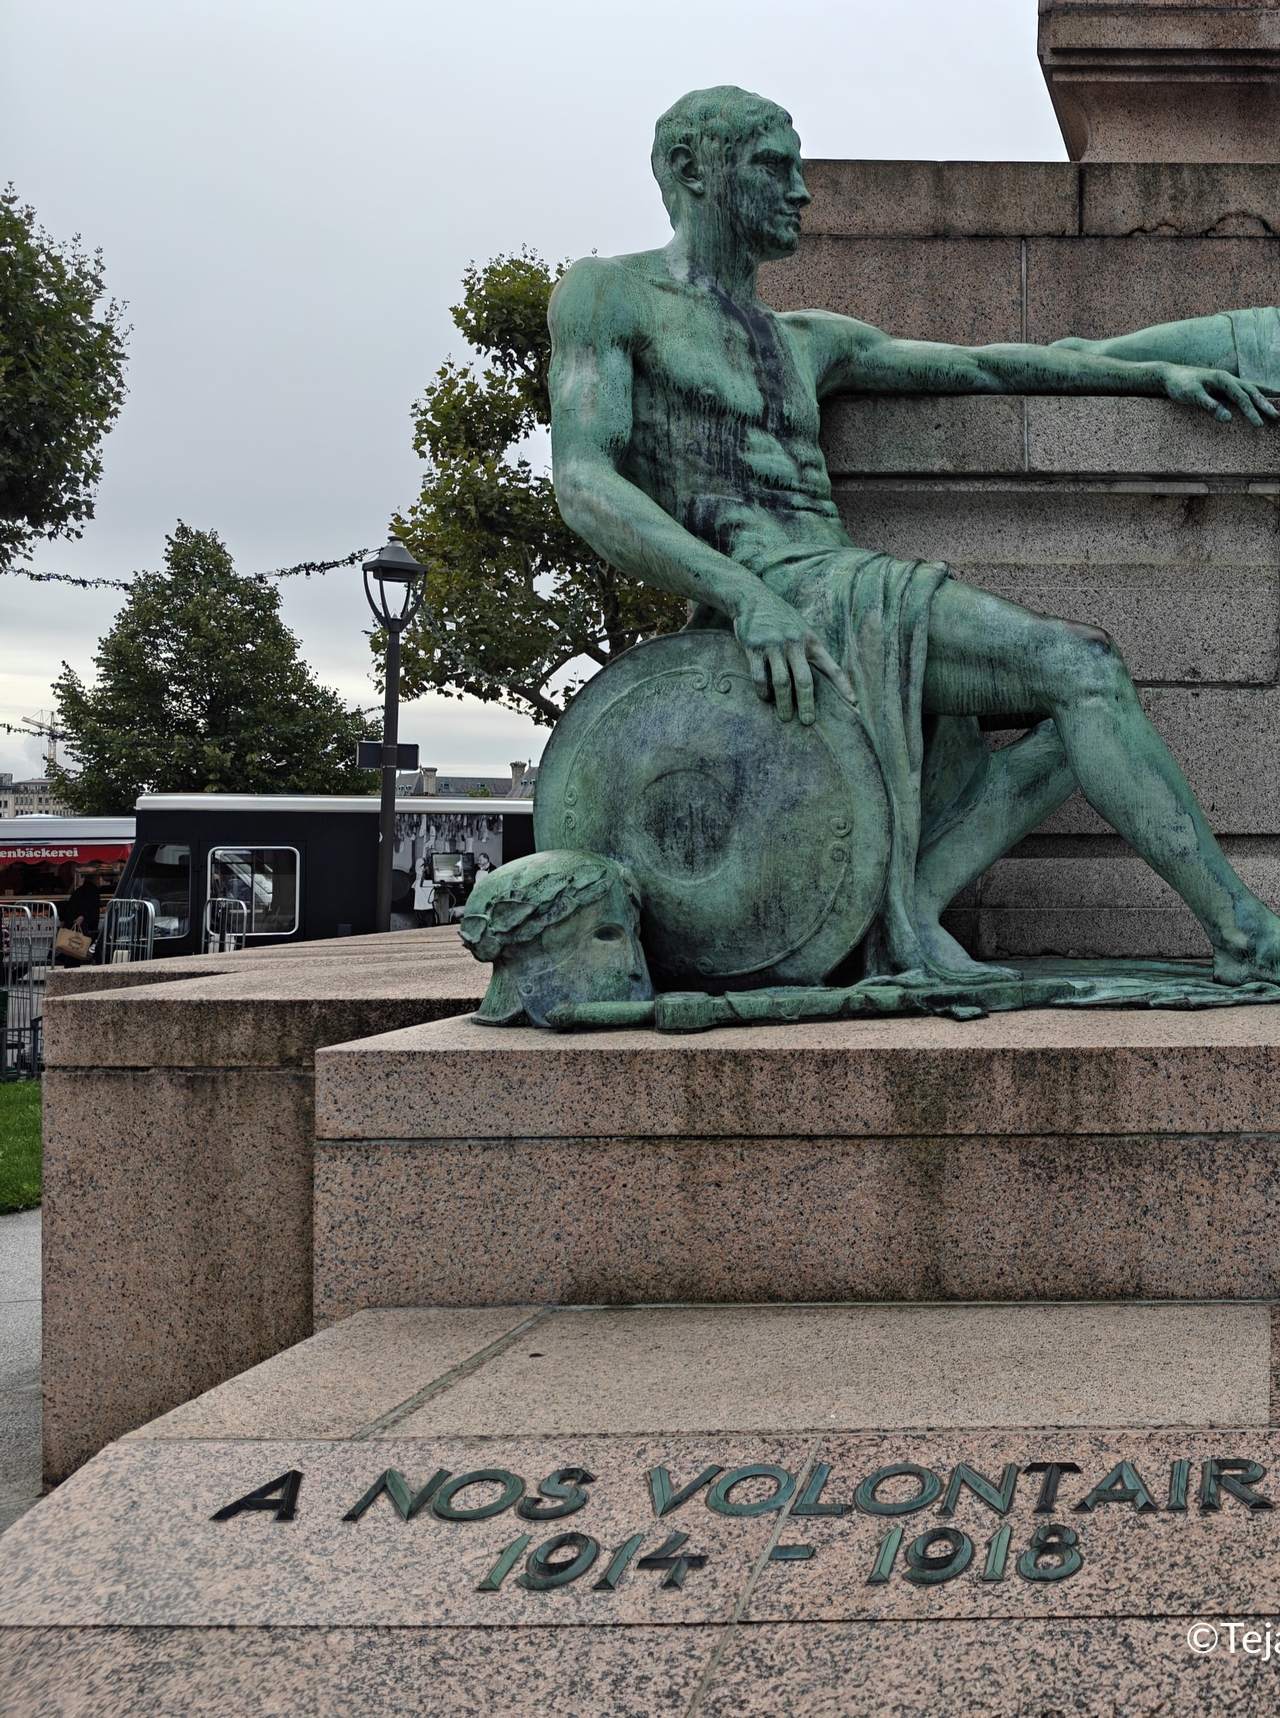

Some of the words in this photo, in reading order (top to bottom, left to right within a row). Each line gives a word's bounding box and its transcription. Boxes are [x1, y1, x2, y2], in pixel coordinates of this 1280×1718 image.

[209, 1468, 303, 1522] A
[341, 1467, 597, 1522] NOS
[474, 1531, 709, 1593] 1914
[768, 1543, 816, 1561] -
[866, 1523, 1083, 1586] 1918
